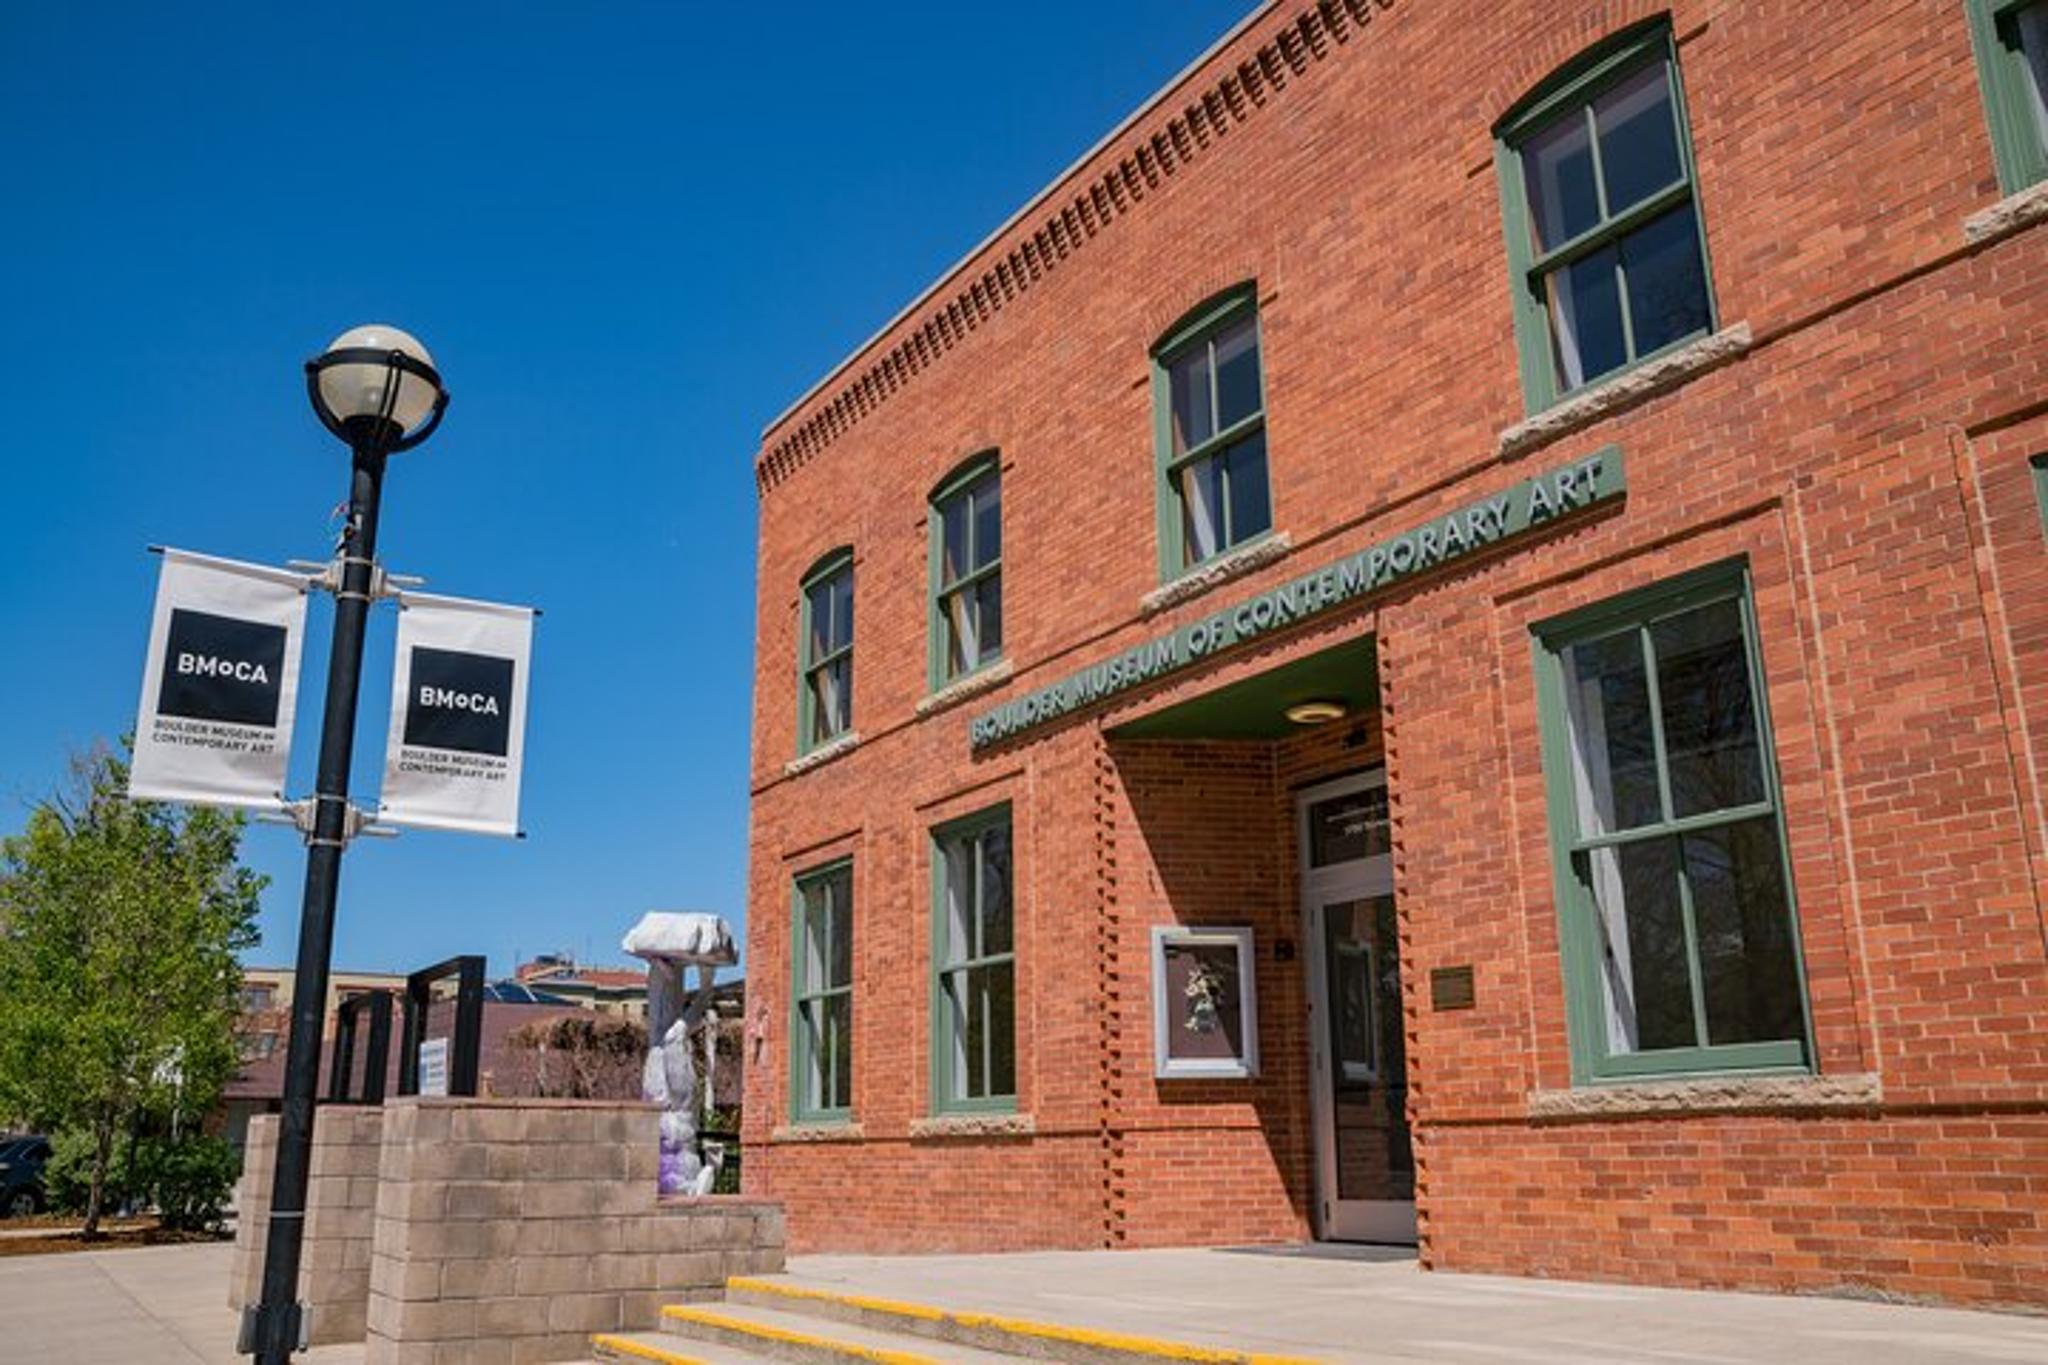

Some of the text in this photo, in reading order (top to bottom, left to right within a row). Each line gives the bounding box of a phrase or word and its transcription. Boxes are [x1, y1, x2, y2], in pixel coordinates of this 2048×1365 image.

[971, 457, 1603, 744] BOULDER MUSEUM OF CONTEMPORARY ART
[155, 720, 208, 734] BOULDER
[211, 727, 262, 741] MUSEUM
[153, 732, 275, 755] CONTEMPORARY ART
[401, 750, 448, 763] BOULDER
[452, 756, 495, 769] MUSEUM
[399, 761, 507, 781] CONTEMPORARY ART
